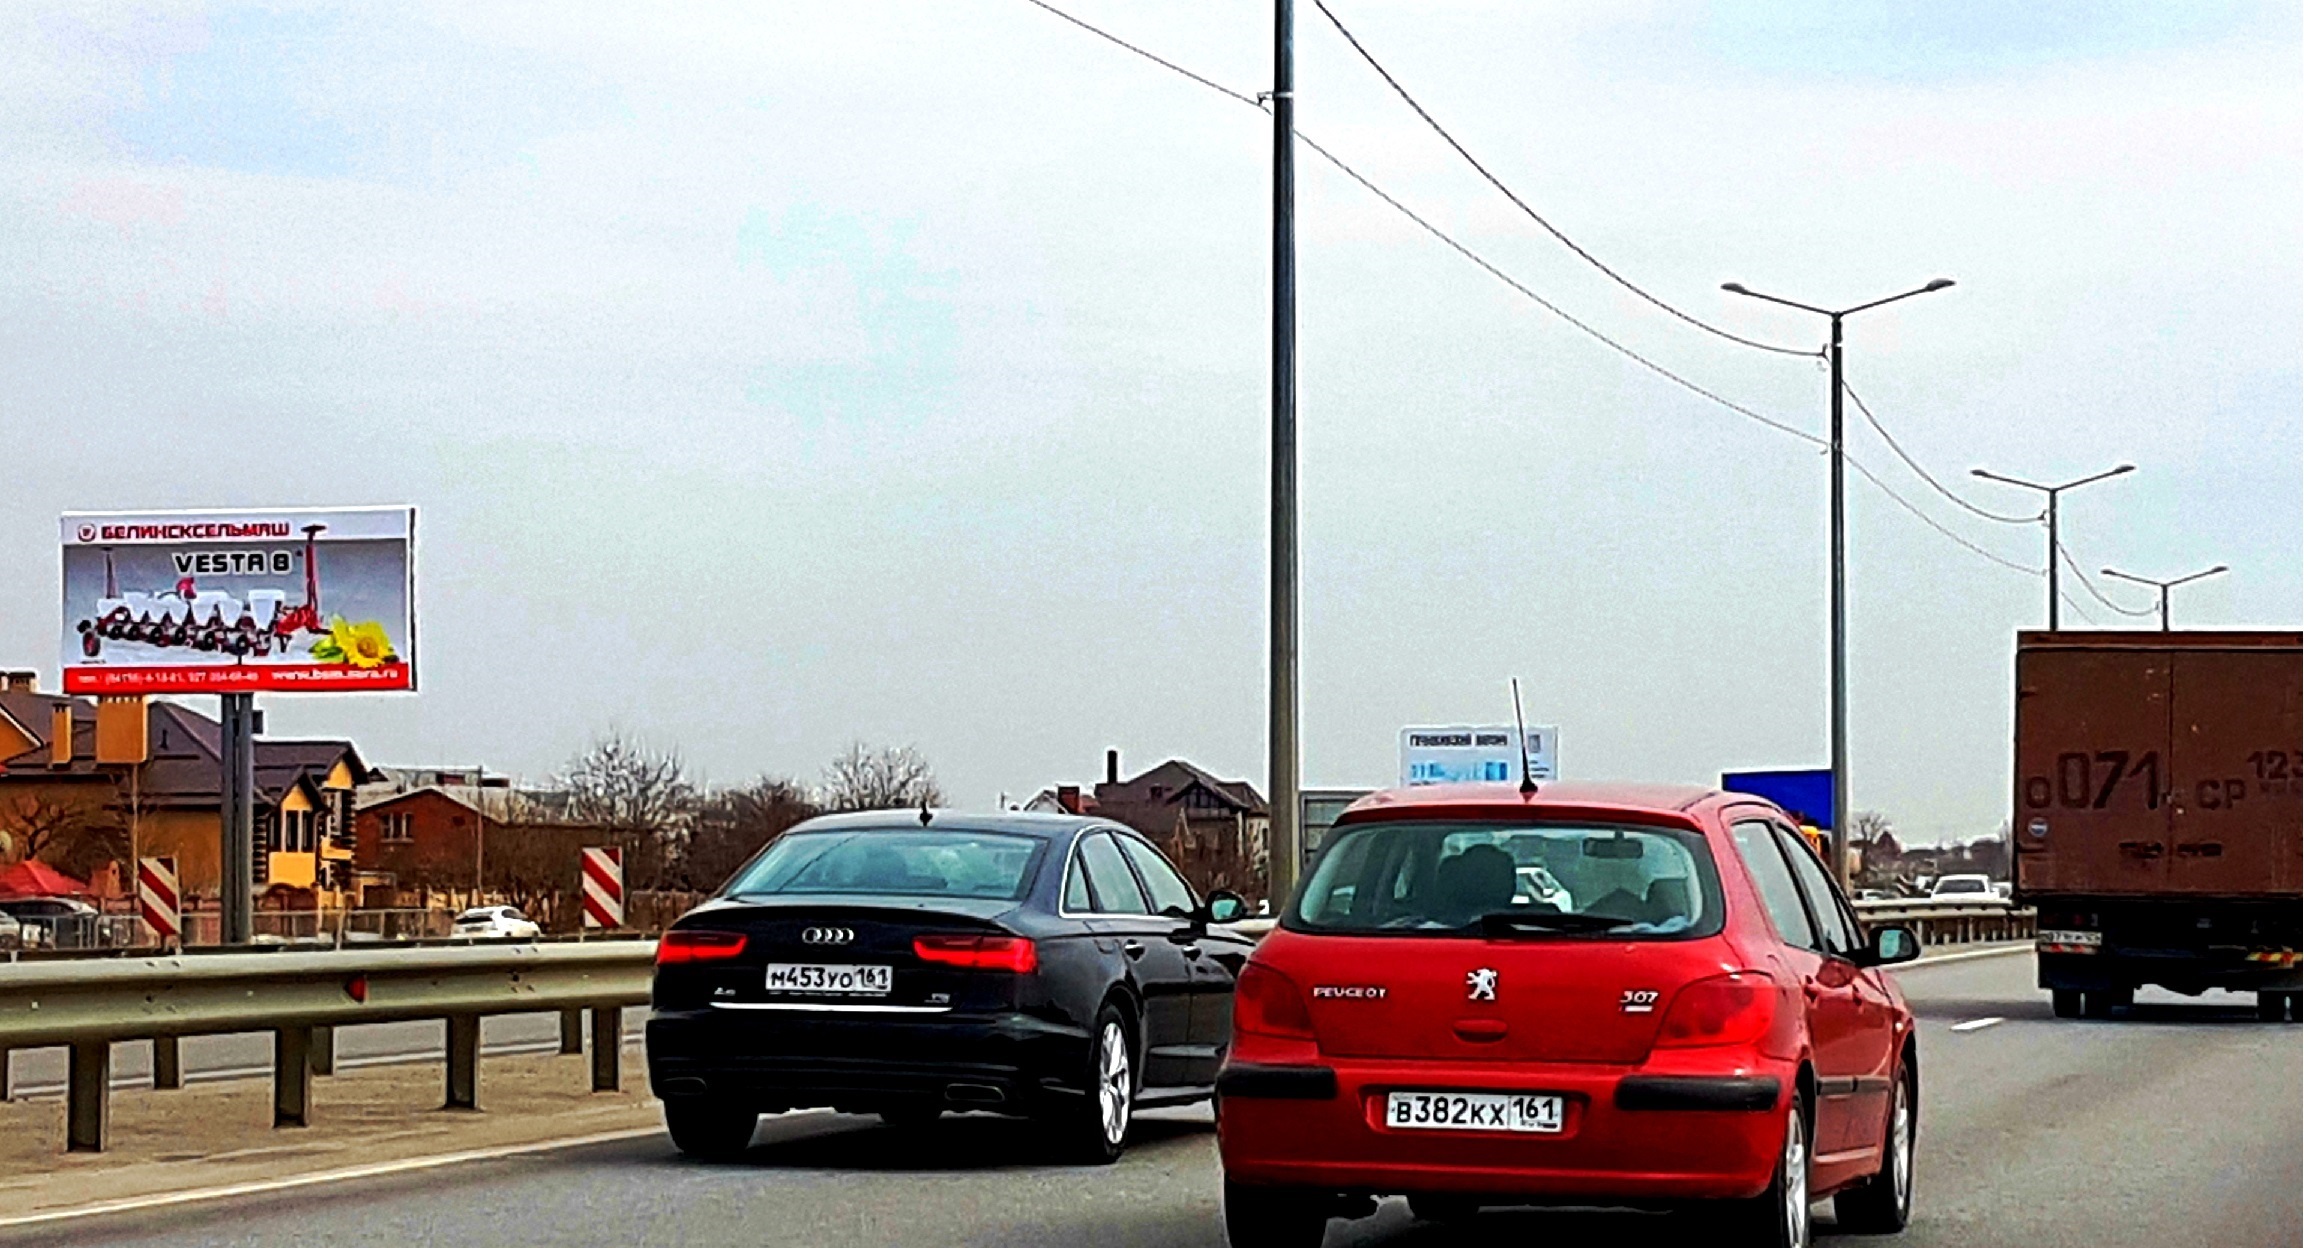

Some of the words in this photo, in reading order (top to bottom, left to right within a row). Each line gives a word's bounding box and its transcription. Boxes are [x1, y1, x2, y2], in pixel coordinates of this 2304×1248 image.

[101, 523, 290, 540] БЕЛИНСКСЕЛЬМАШ
[175, 552, 265, 573] VESTA
[273, 552, 290, 572] 8
[854, 966, 889, 988] 161
[1313, 986, 1387, 999] PEUGEOT
[1619, 990, 1660, 1004] 307
[1512, 1097, 1555, 1121] 161
